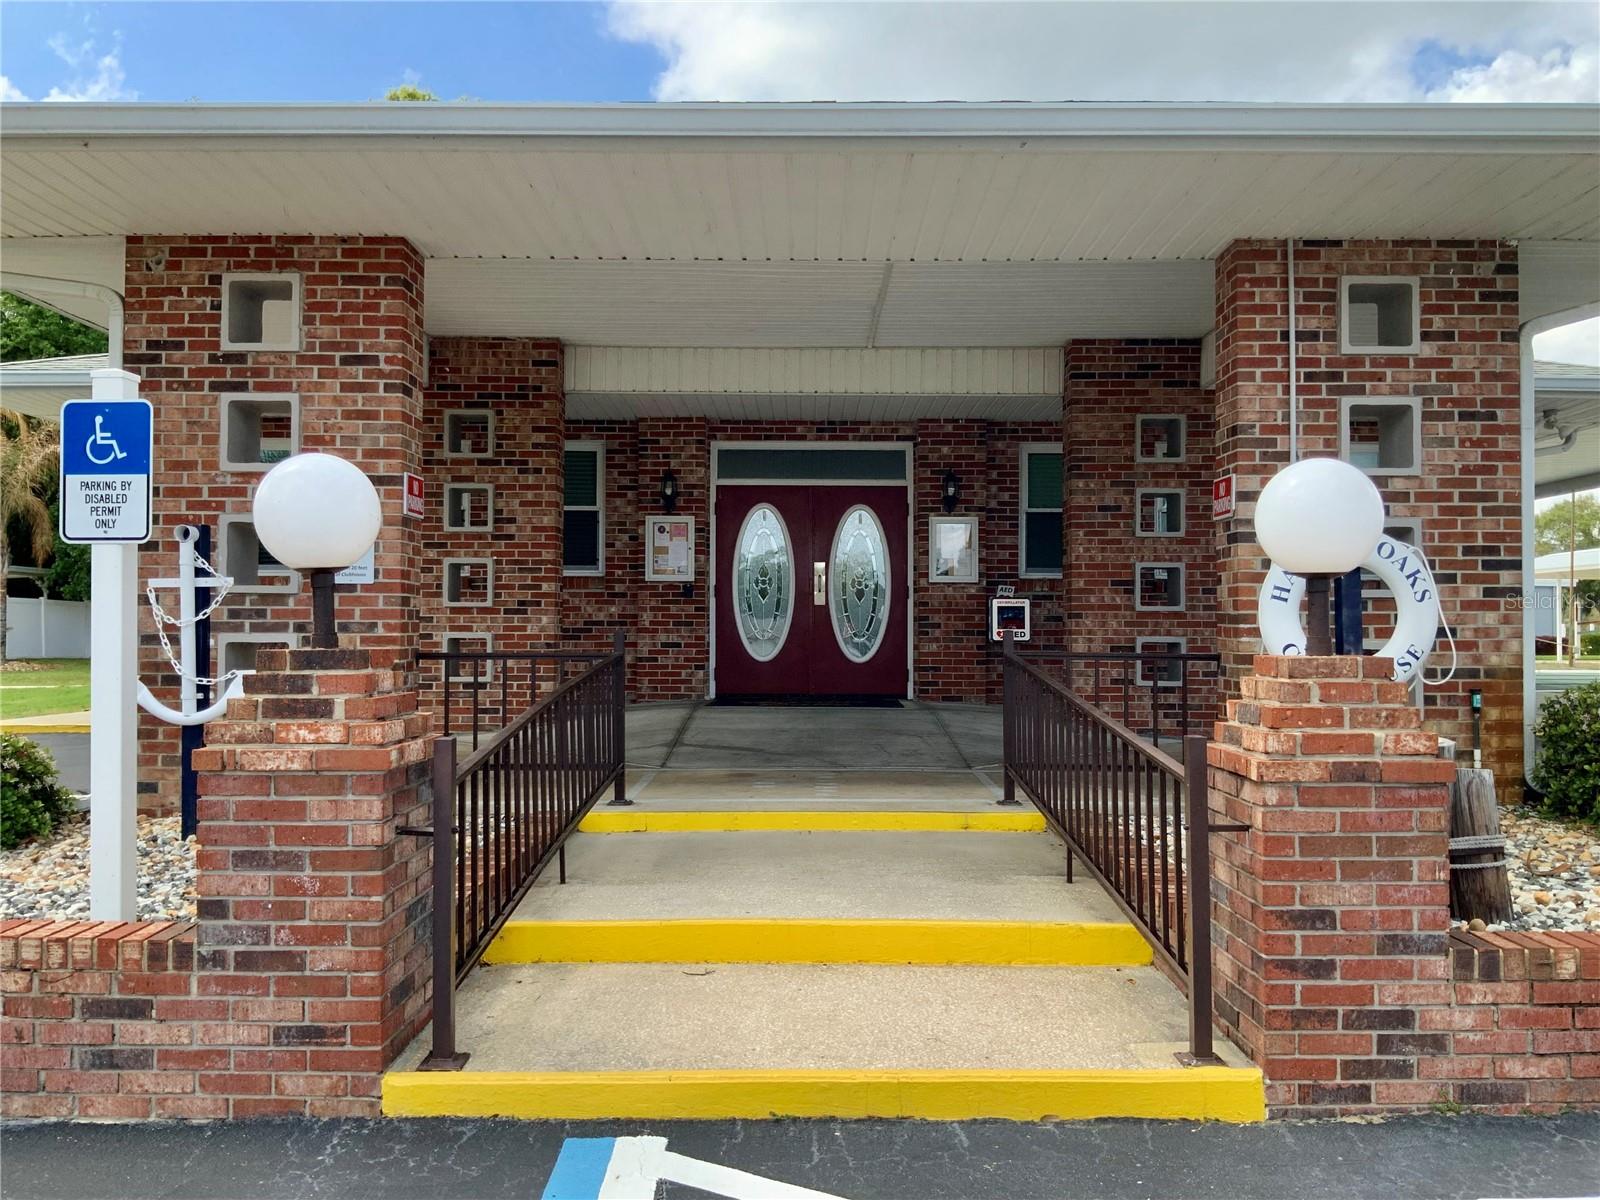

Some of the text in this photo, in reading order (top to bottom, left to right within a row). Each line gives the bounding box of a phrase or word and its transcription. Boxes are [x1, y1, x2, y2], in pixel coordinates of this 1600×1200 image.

[80, 481, 132, 491] PARKING BY
[413, 480, 419, 496] NO
[1219, 481, 1226, 497] NO
[85, 494, 127, 504] DISABLED
[90, 506, 122, 516] PERMIT
[95, 519, 116, 529] ONLY
[1377, 541, 1432, 603] OAKS
